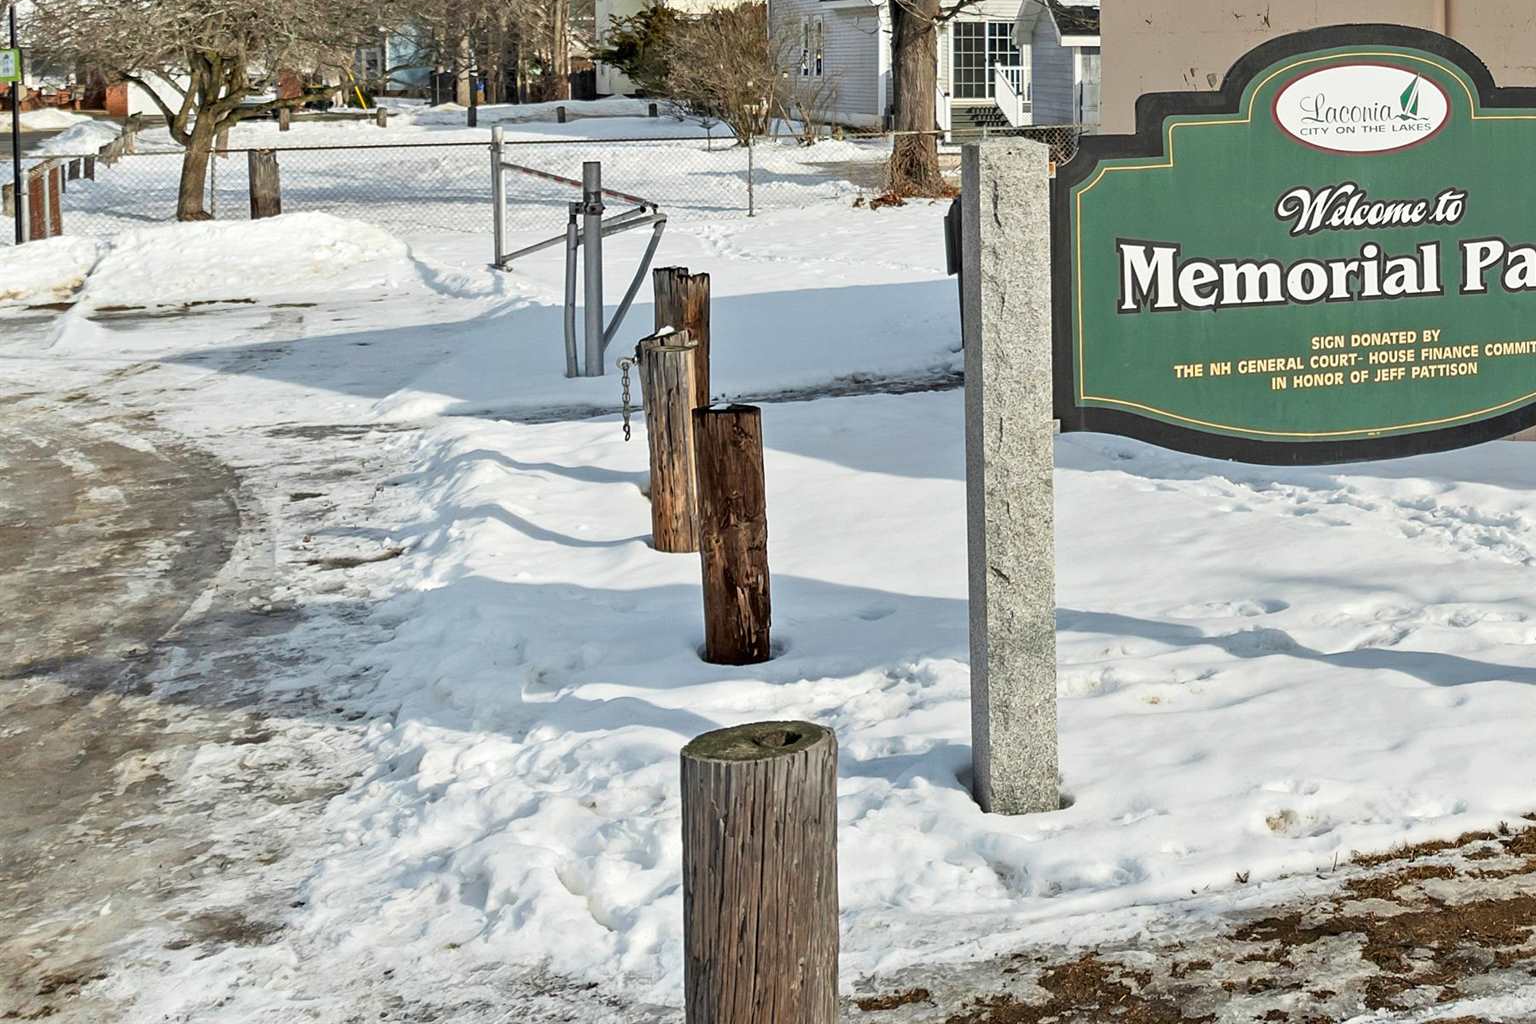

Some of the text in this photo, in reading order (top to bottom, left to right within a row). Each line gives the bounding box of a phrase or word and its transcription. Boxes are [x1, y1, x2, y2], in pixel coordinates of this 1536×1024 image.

[1299, 92, 1393, 124] Laconia
[1300, 123, 1432, 136] CITY ON THE LAKES
[1277, 183, 1467, 234] Welcome to
[1119, 243, 1442, 311] Memorial
[1311, 329, 1441, 350] SIGN DONATED BY
[1174, 363, 1203, 378] THE
[1210, 362, 1231, 376] NH
[1238, 357, 1304, 374] GENERAL
[1368, 349, 1415, 365] HOUSE
[1421, 345, 1479, 361] FINANCE
[1271, 362, 1478, 390] IN HONOR OF JEFF PATTISON
